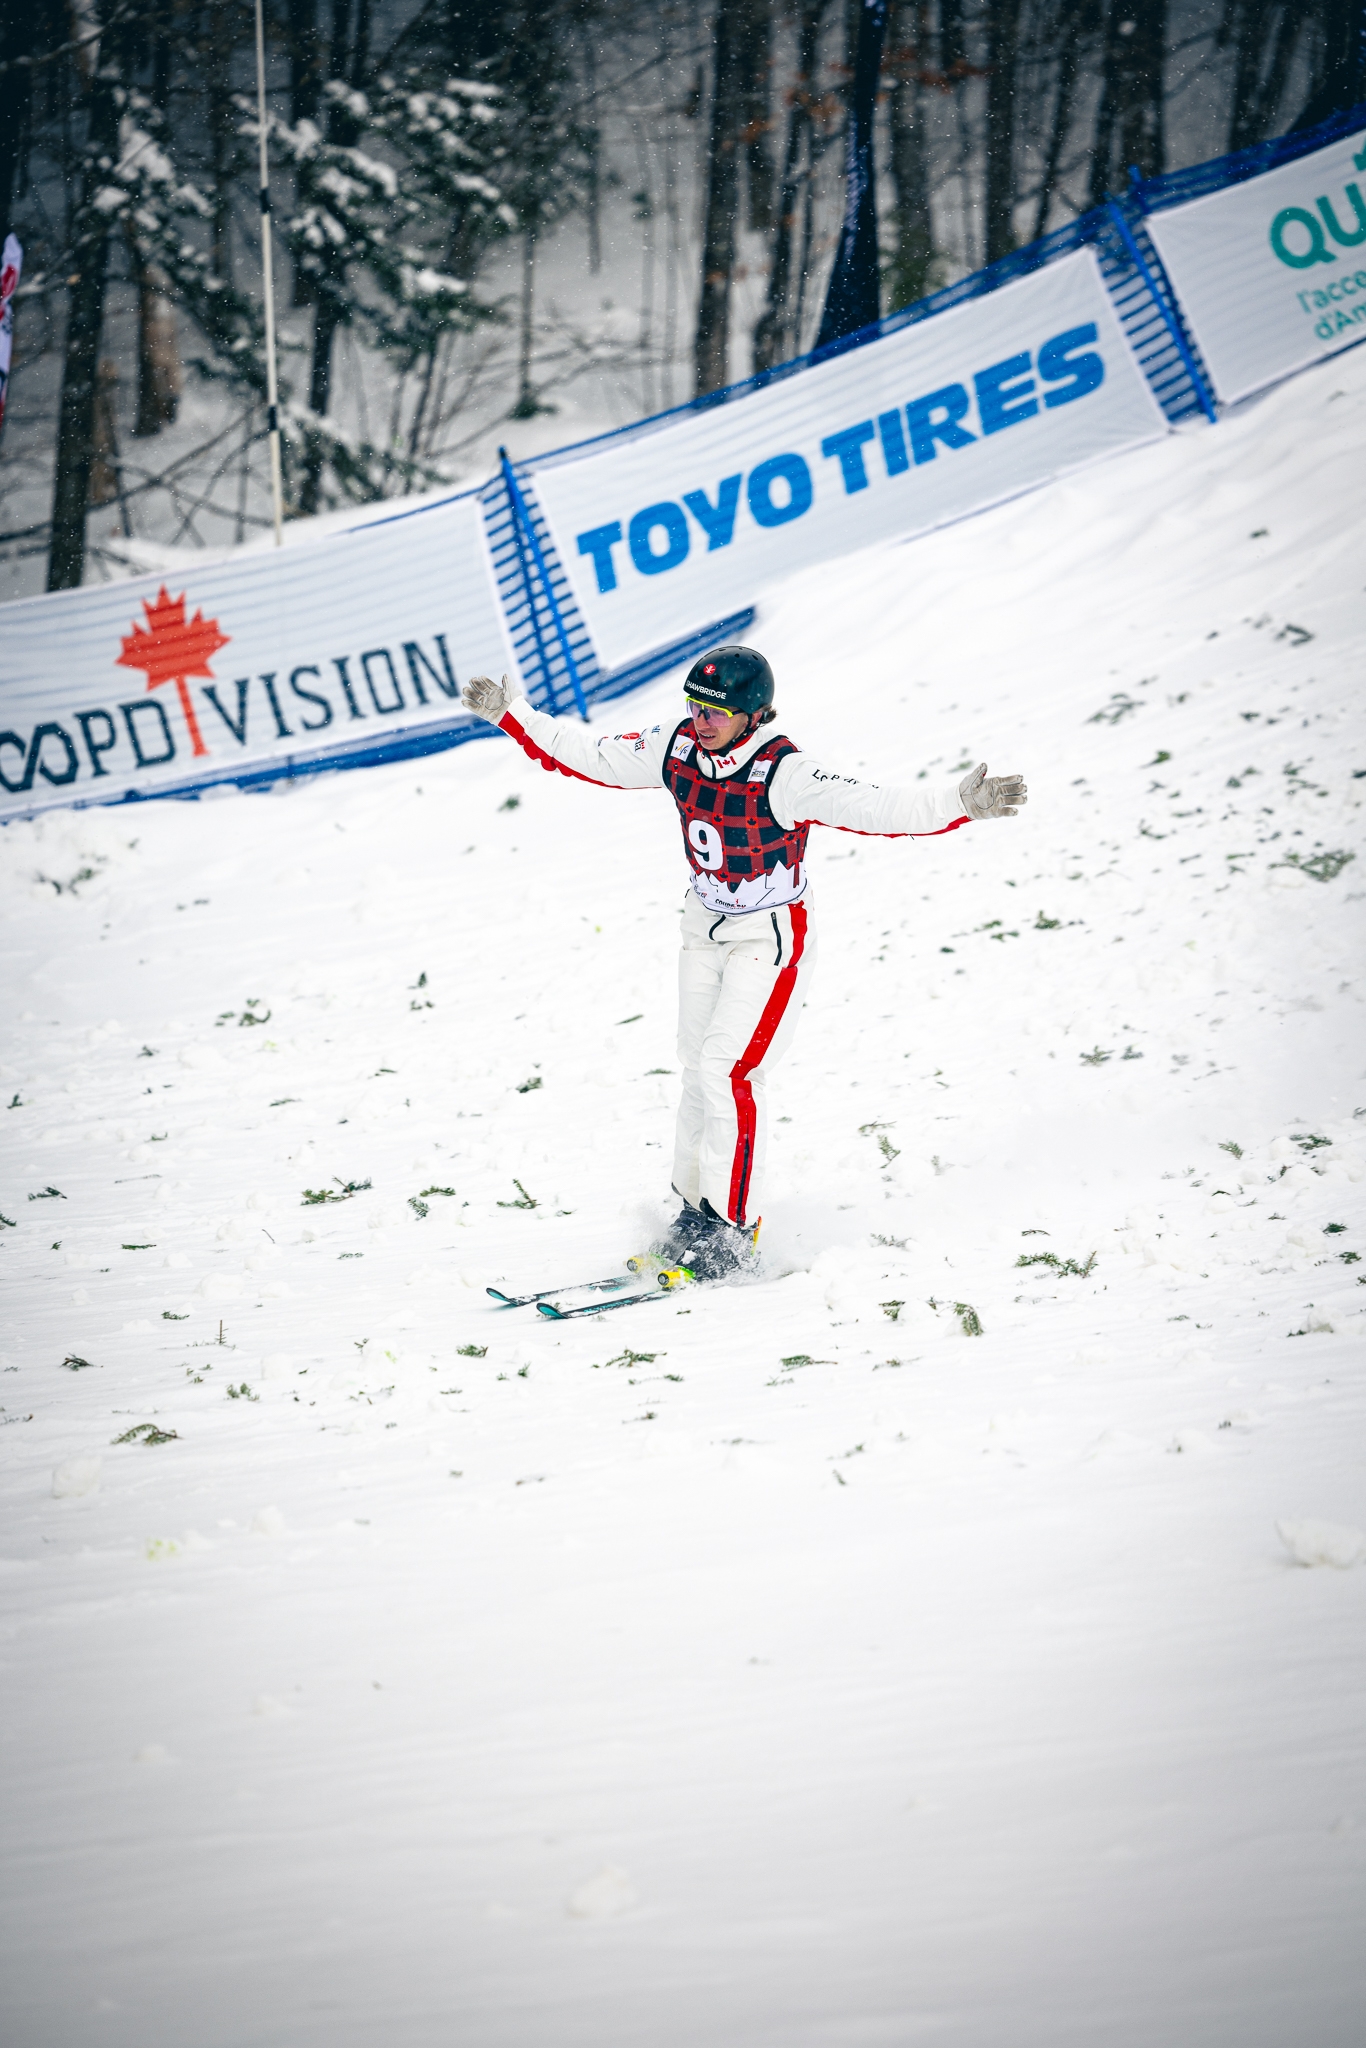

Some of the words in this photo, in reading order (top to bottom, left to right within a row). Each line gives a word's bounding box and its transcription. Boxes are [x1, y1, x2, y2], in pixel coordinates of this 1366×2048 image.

[576, 451, 813, 594] TOYO
[821, 321, 1105, 494] TIRES
[688, 819, 724, 871] 9
